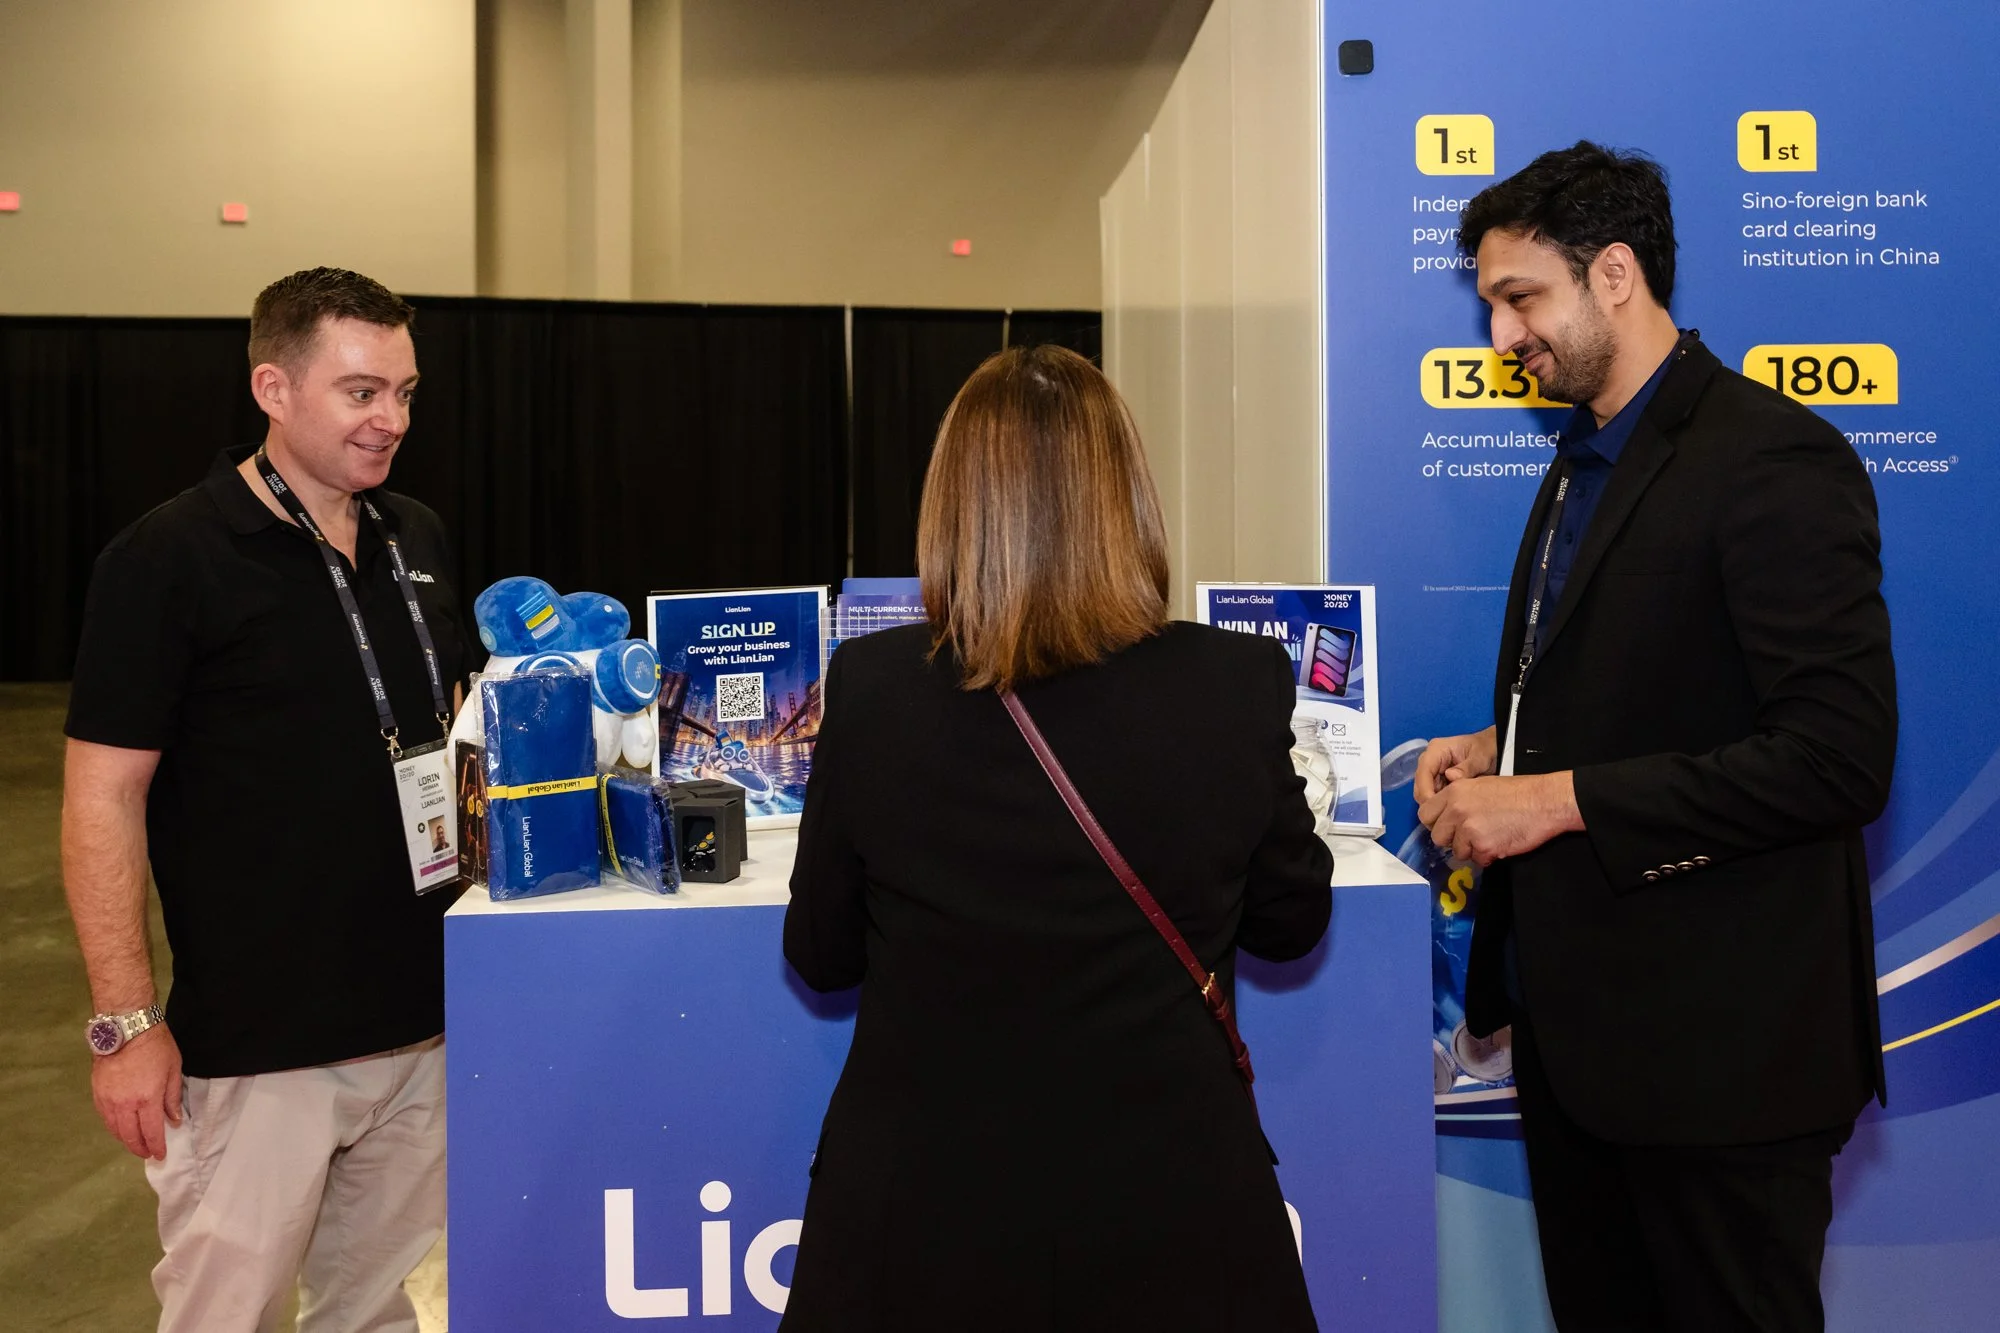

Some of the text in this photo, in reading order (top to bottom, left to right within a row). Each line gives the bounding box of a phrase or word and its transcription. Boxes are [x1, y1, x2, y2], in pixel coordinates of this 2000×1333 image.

[1433, 128, 1477, 164] 1st
[1755, 124, 1800, 160] 1st
[1742, 190, 1928, 212] Sino-foreign bank
[1742, 220, 1876, 240] card clearing
[1743, 248, 1940, 267] institution in China
[1434, 359, 1542, 399] 13.3
[1421, 430, 1560, 449] Accumulated
[1422, 459, 1443, 477] of
[1216, 595, 1274, 604] LianLian Global
[701, 621, 776, 638] SIGN UP
[1261, 621, 1288, 639] AN
[687, 641, 791, 655] Grow your business
[704, 653, 774, 665] with LianLian
[417, 772, 441, 786] LORIN
[527, 784, 551, 794] Global
[522, 816, 533, 877] LianLian Global
